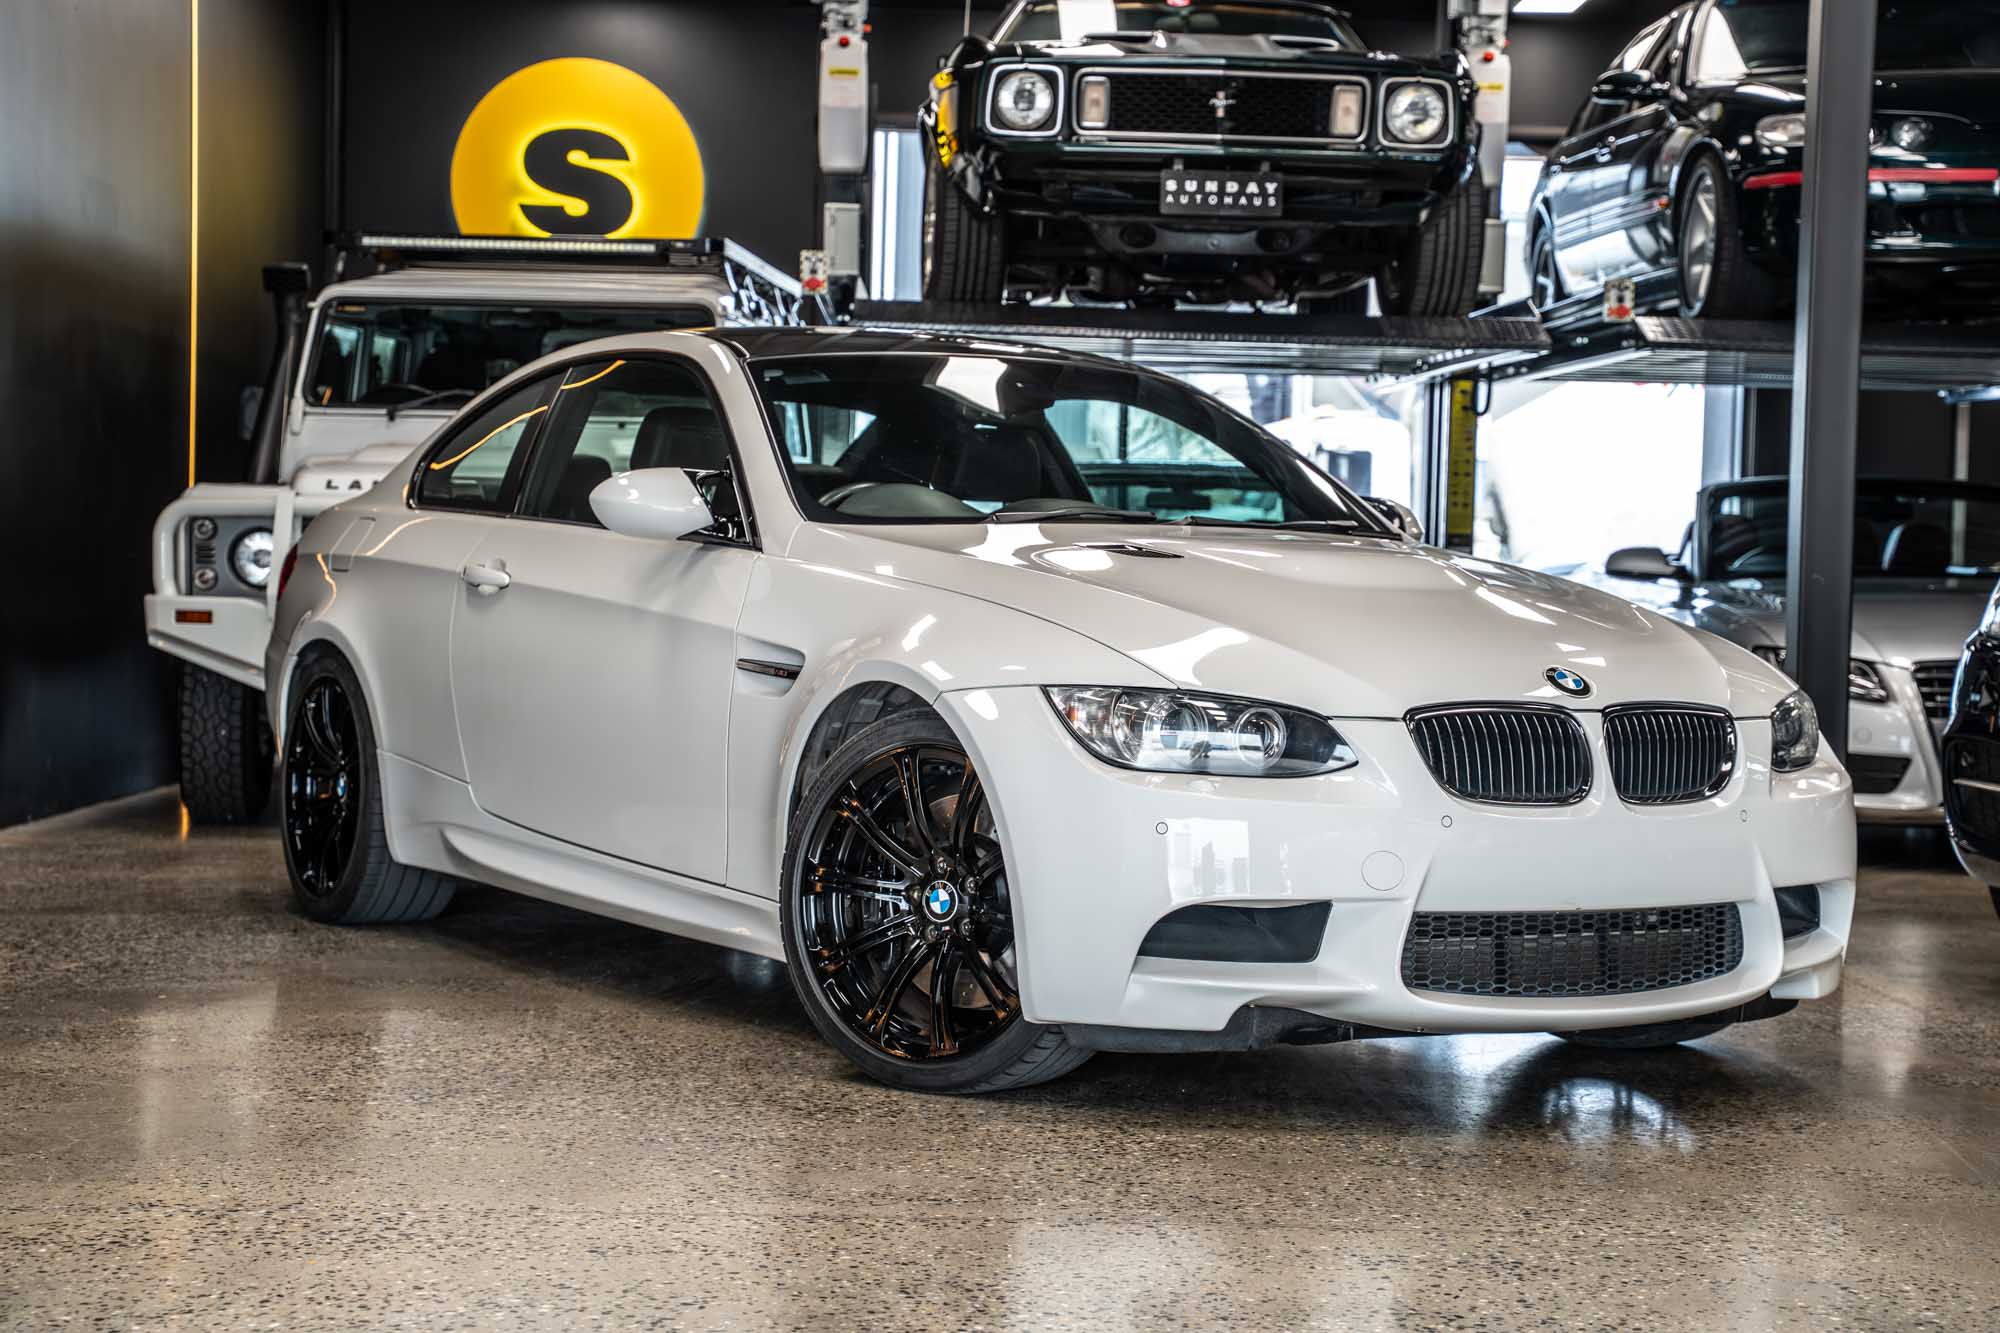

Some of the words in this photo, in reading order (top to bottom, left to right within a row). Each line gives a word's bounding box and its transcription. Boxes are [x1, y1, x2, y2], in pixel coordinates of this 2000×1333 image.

[519, 128, 633, 238] S
[1165, 179, 1278, 194] SUNDAY
[1165, 194, 1276, 207] AUTOHAUS
